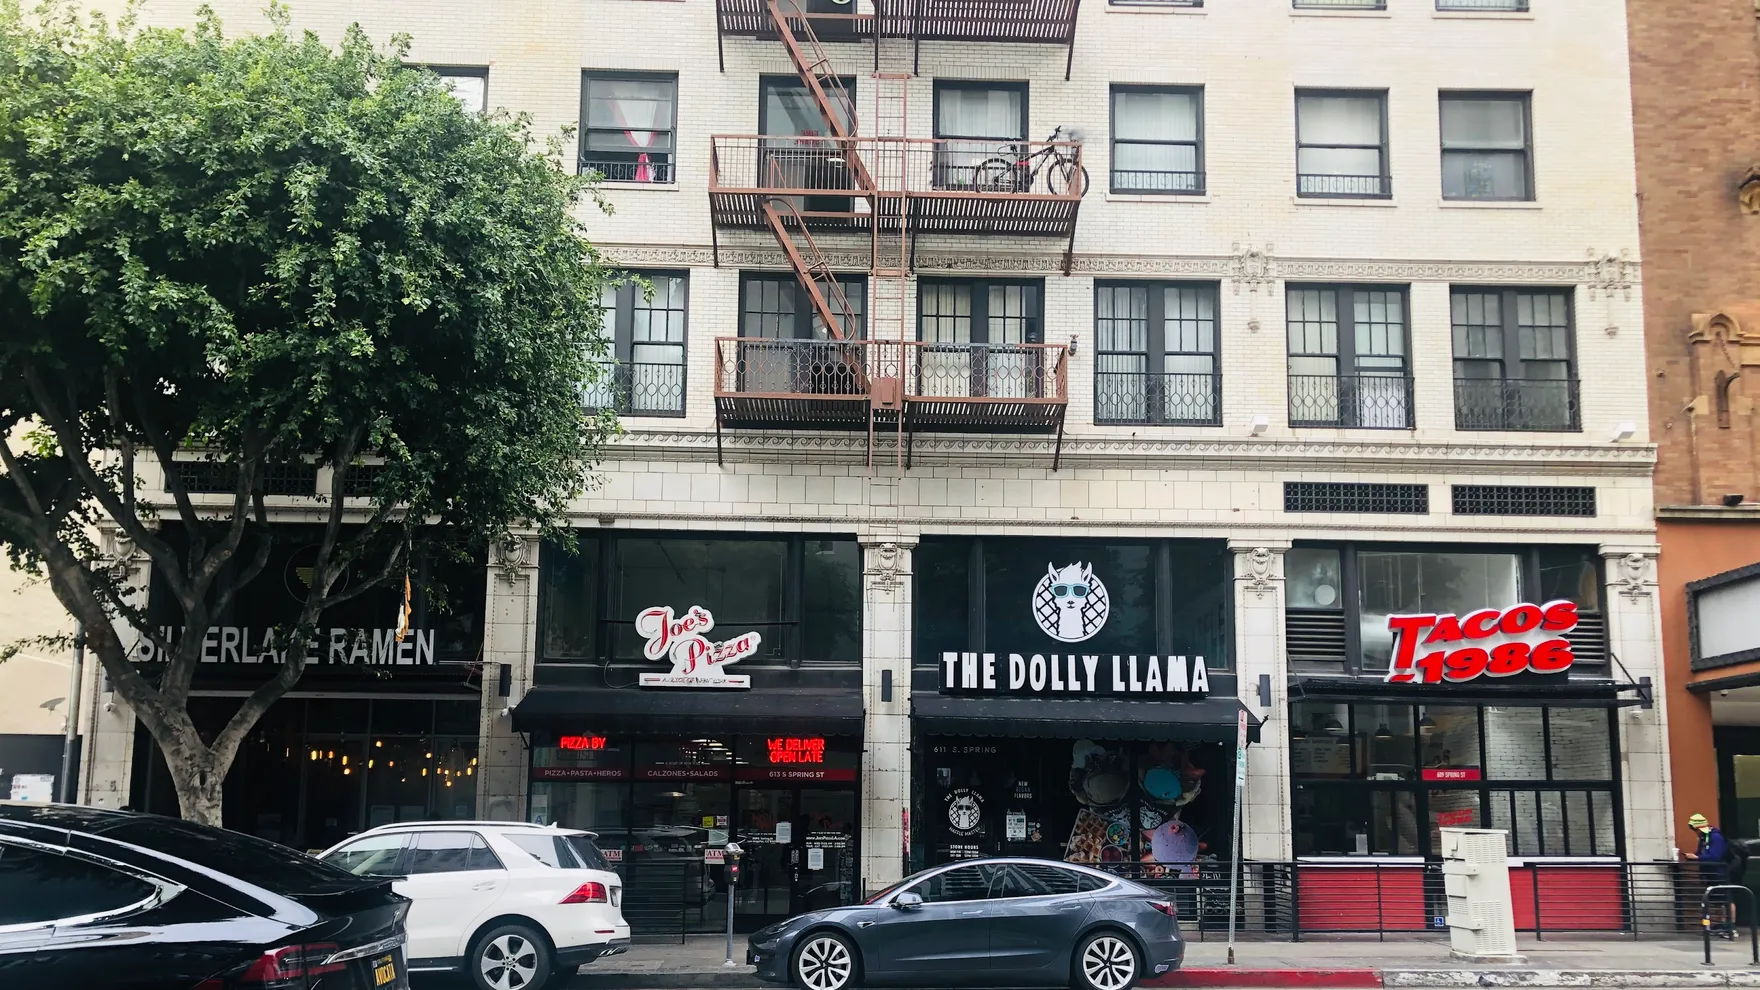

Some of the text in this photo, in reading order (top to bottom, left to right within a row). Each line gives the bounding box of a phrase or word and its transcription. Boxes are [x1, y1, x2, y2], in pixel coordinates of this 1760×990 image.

[136, 625, 436, 665] SILERLAE RAMEN
[640, 610, 709, 655] Joe's
[1388, 602, 1579, 669] TACOS
[673, 638, 750, 675] Pizza
[943, 651, 1210, 692] THE DOLLY LLAMA
[1415, 639, 1575, 683] 1986
[560, 736, 606, 749] PIZZA BY
[767, 738, 825, 750] WE DELIVER
[769, 751, 823, 763] OPEN LATE
